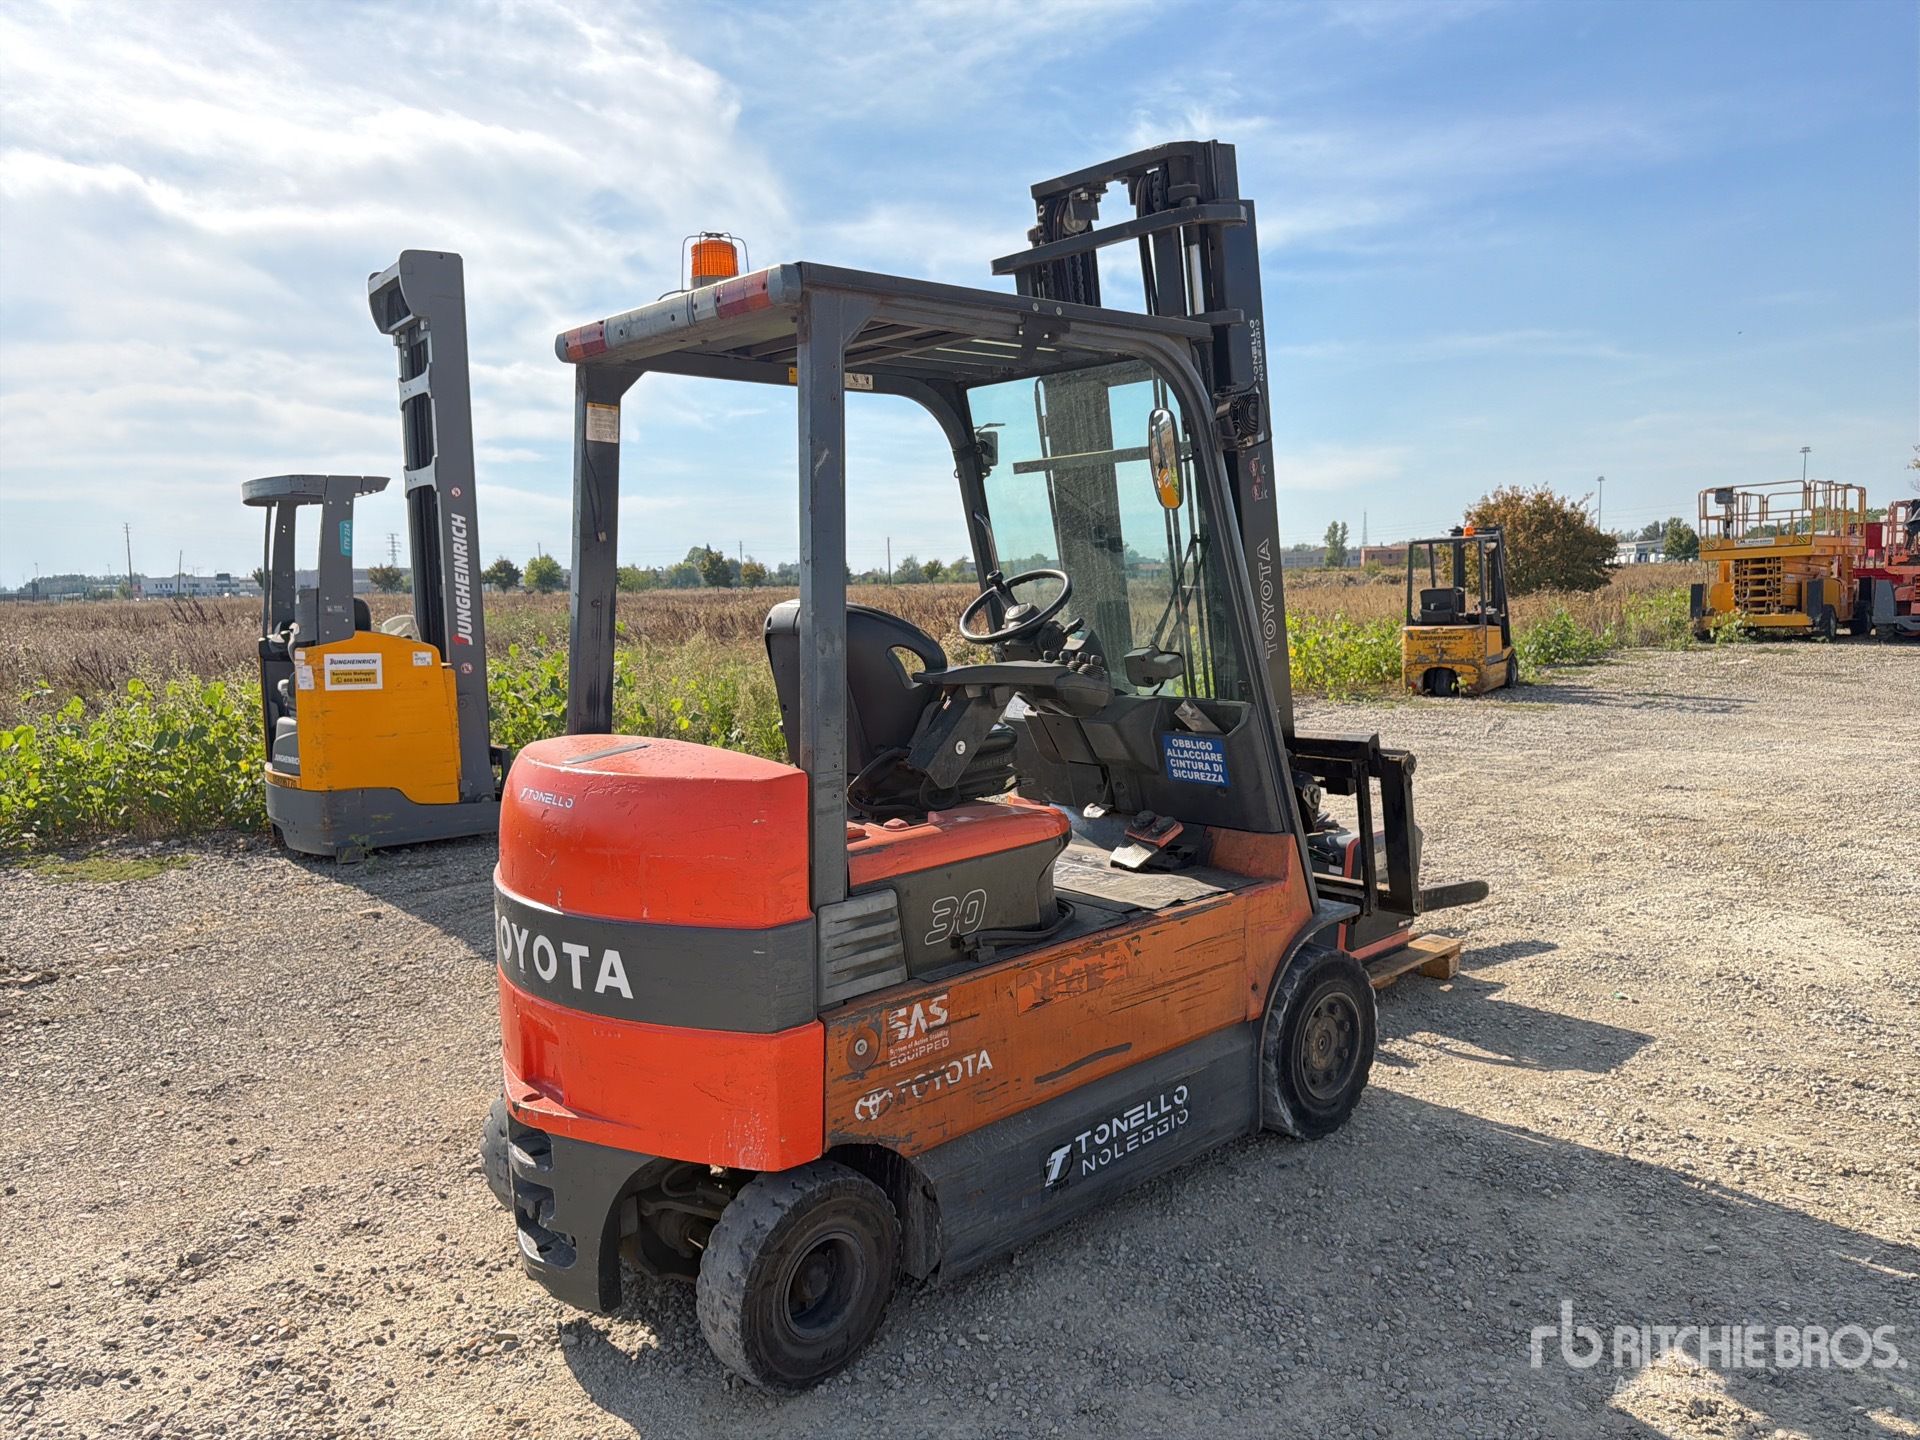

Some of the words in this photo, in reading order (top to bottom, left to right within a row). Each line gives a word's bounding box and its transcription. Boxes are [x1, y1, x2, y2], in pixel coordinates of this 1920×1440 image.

[451, 512, 474, 646] JUNGHEINRICH
[1257, 538, 1278, 660] TOYOTA
[1166, 747, 1224, 763] ALLACCIARE
[1172, 738, 1213, 751] OBBLIGO
[1170, 758, 1211, 772] CINTURA
[1213, 763, 1223, 773] DI
[1172, 768, 1225, 784] SICUREZZA
[528, 789, 574, 809] TONELLO
[924, 888, 987, 946] 30
[888, 993, 949, 1041] SAS
[889, 1037, 950, 1068] EQUIPPED
[913, 1037, 929, 1047] Active
[928, 1030, 949, 1041] Stability
[1075, 1085, 1189, 1154] TONELLO
[1081, 1108, 1189, 1176] NOLEGGIO
